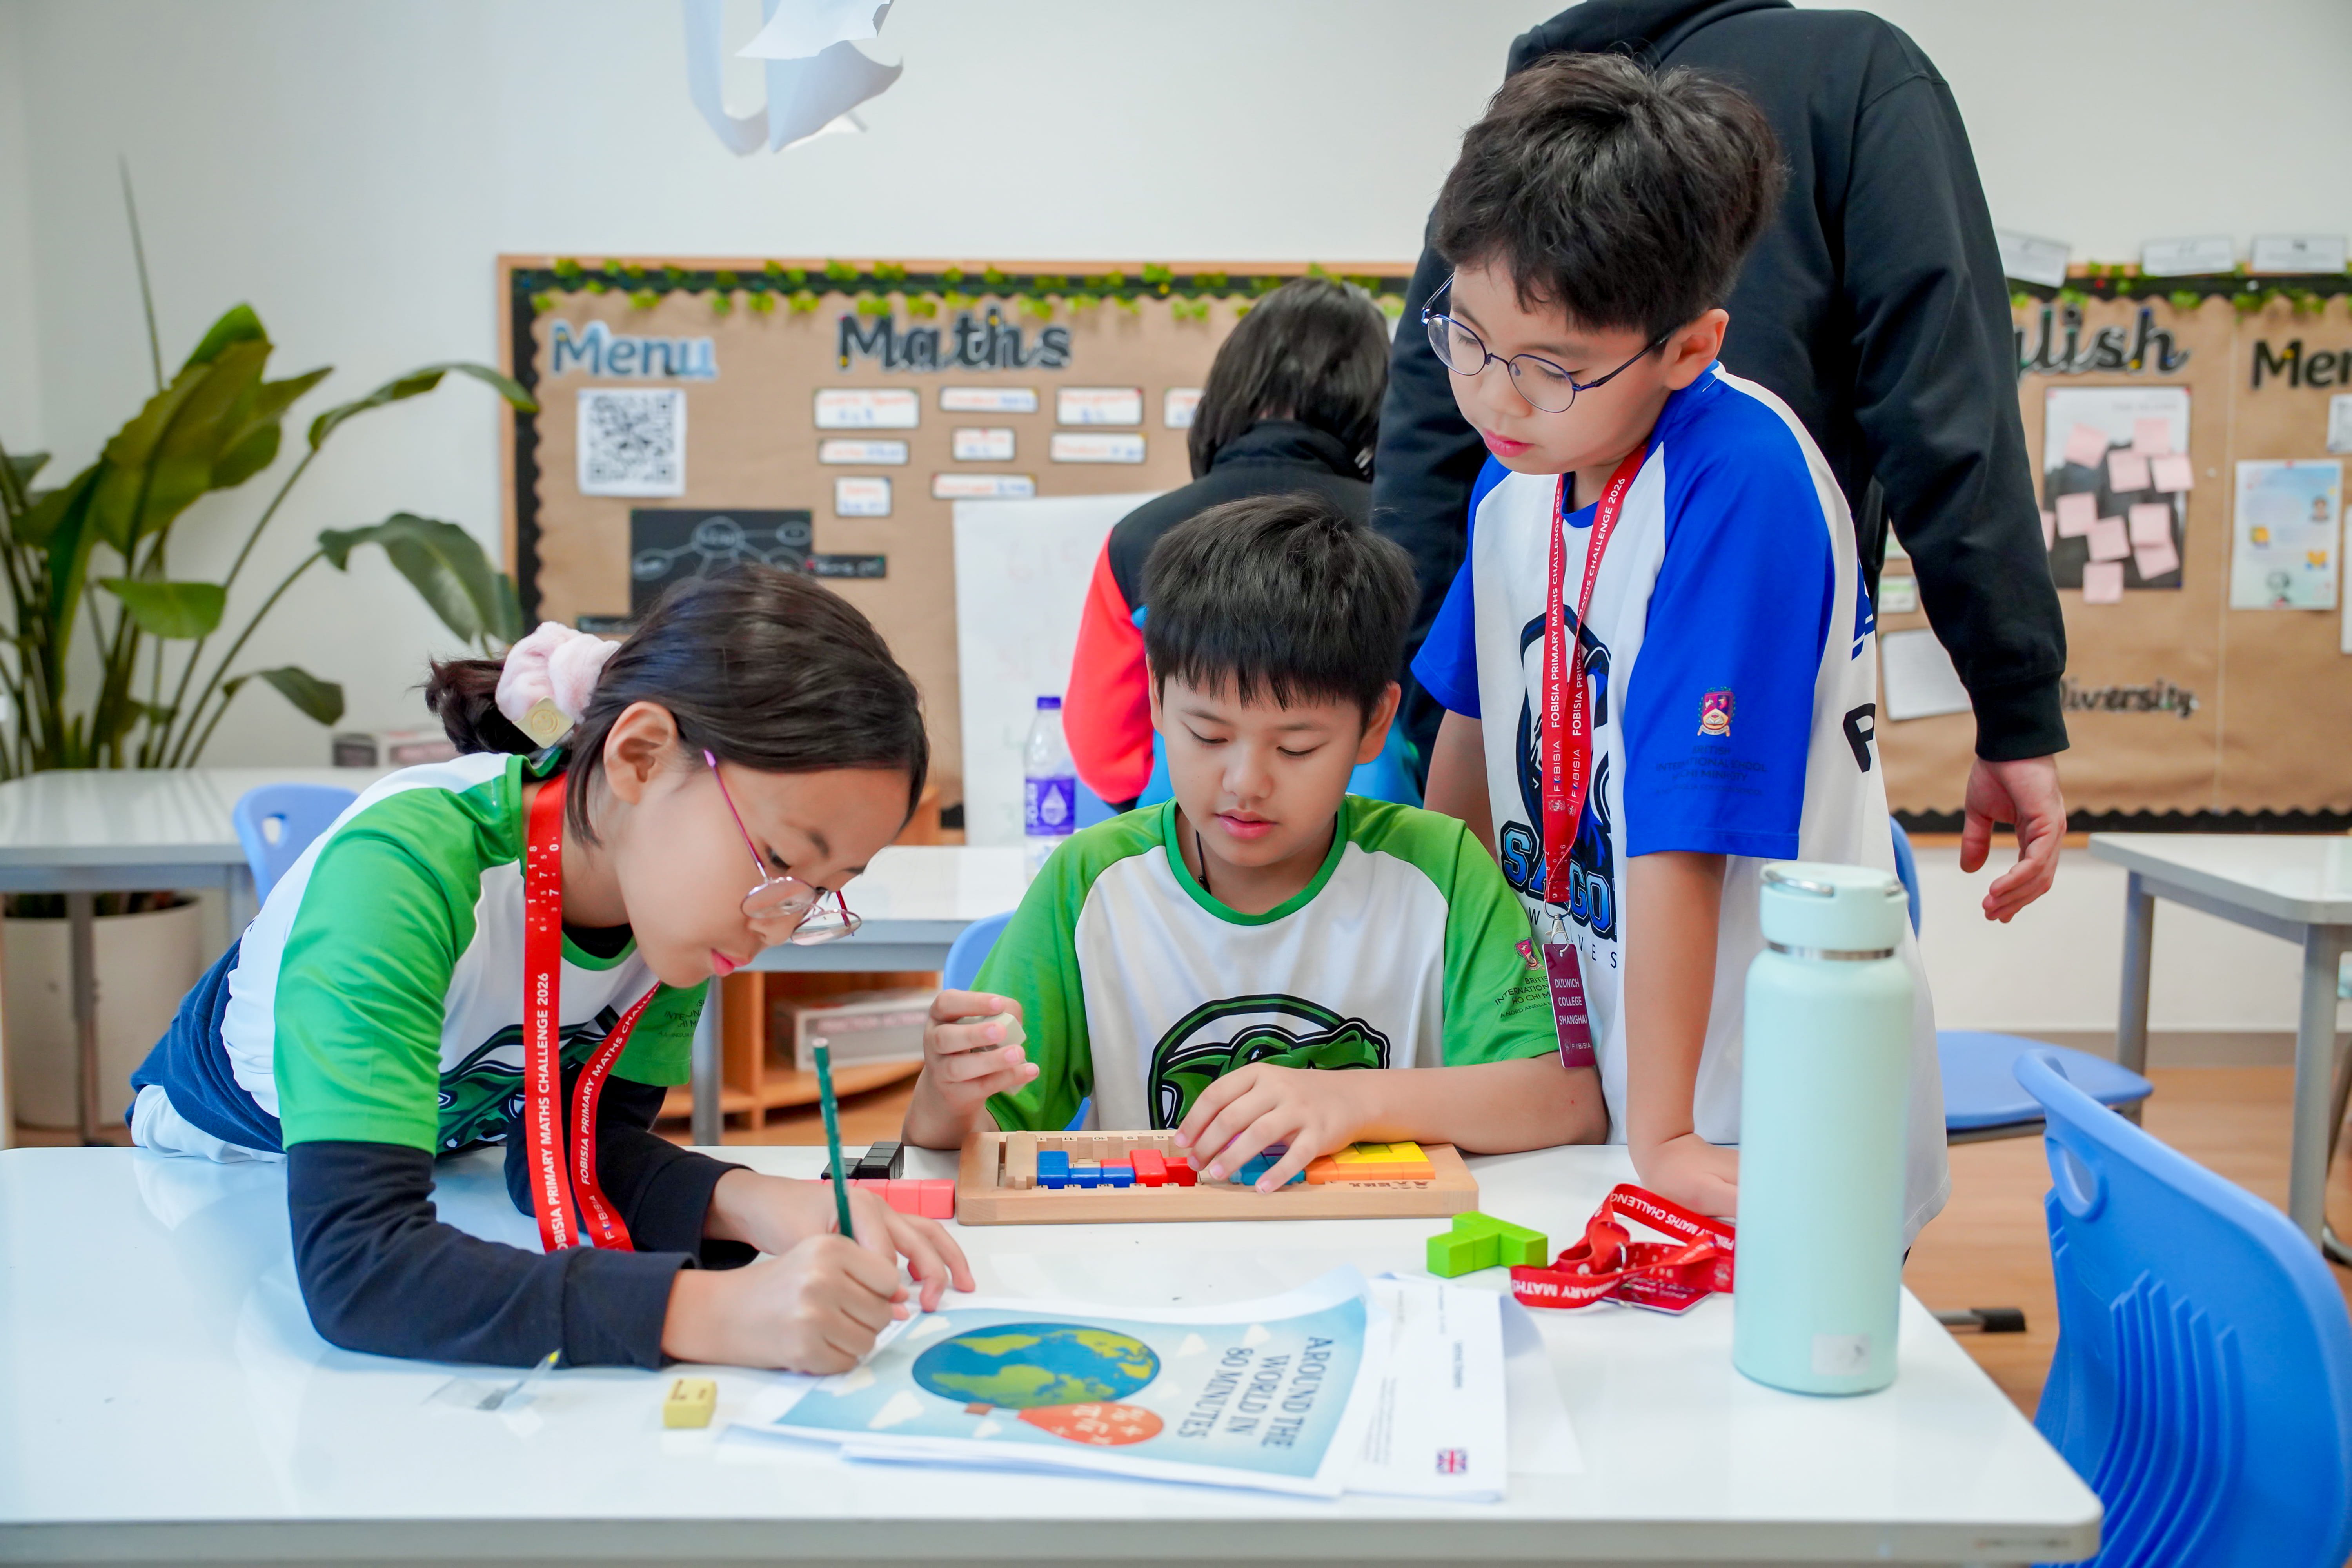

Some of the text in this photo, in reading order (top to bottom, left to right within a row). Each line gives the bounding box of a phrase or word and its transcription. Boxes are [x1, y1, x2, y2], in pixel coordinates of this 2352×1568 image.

[554, 322, 717, 378] Menu
[839, 307, 1071, 369] Maths
[2015, 303, 2190, 376] lish
[1572, 691, 1583, 736] FOBISIA
[1578, 580, 1591, 619] MATHS
[1589, 507, 1613, 577] CHALLENGE
[1608, 478, 1626, 505] 2026
[1551, 630, 1559, 681] PRIMARY
[1551, 683, 1560, 728] FOBISIA
[1529, 907, 1617, 969] WVES
[1495, 984, 1549, 1006] INTERNATION
[1525, 976, 1548, 984] BRITIS
[1555, 979, 1579, 988] DULWICH
[1558, 997, 1582, 1006] COLLEGE
[1506, 1008, 1523, 1017] NORD
[1525, 1003, 1547, 1011] ANGLIA
[1559, 1015, 1587, 1025] SHANGHAI
[592, 1036, 623, 1078] MATHS
[537, 973, 568, 1250] OBISIA PRIMARY MATHS CHALLENGE 2026
[581, 1078, 594, 1135] PRIMARY
[579, 1138, 590, 1186] FOBISIA
[1666, 1214, 1700, 1235] MATHS
[1177, 1347, 1254, 1439] 80 MINUTES
[1225, 1354, 1290, 1436] WORLD IN
[1260, 1336, 1334, 1448] AROUND THE
